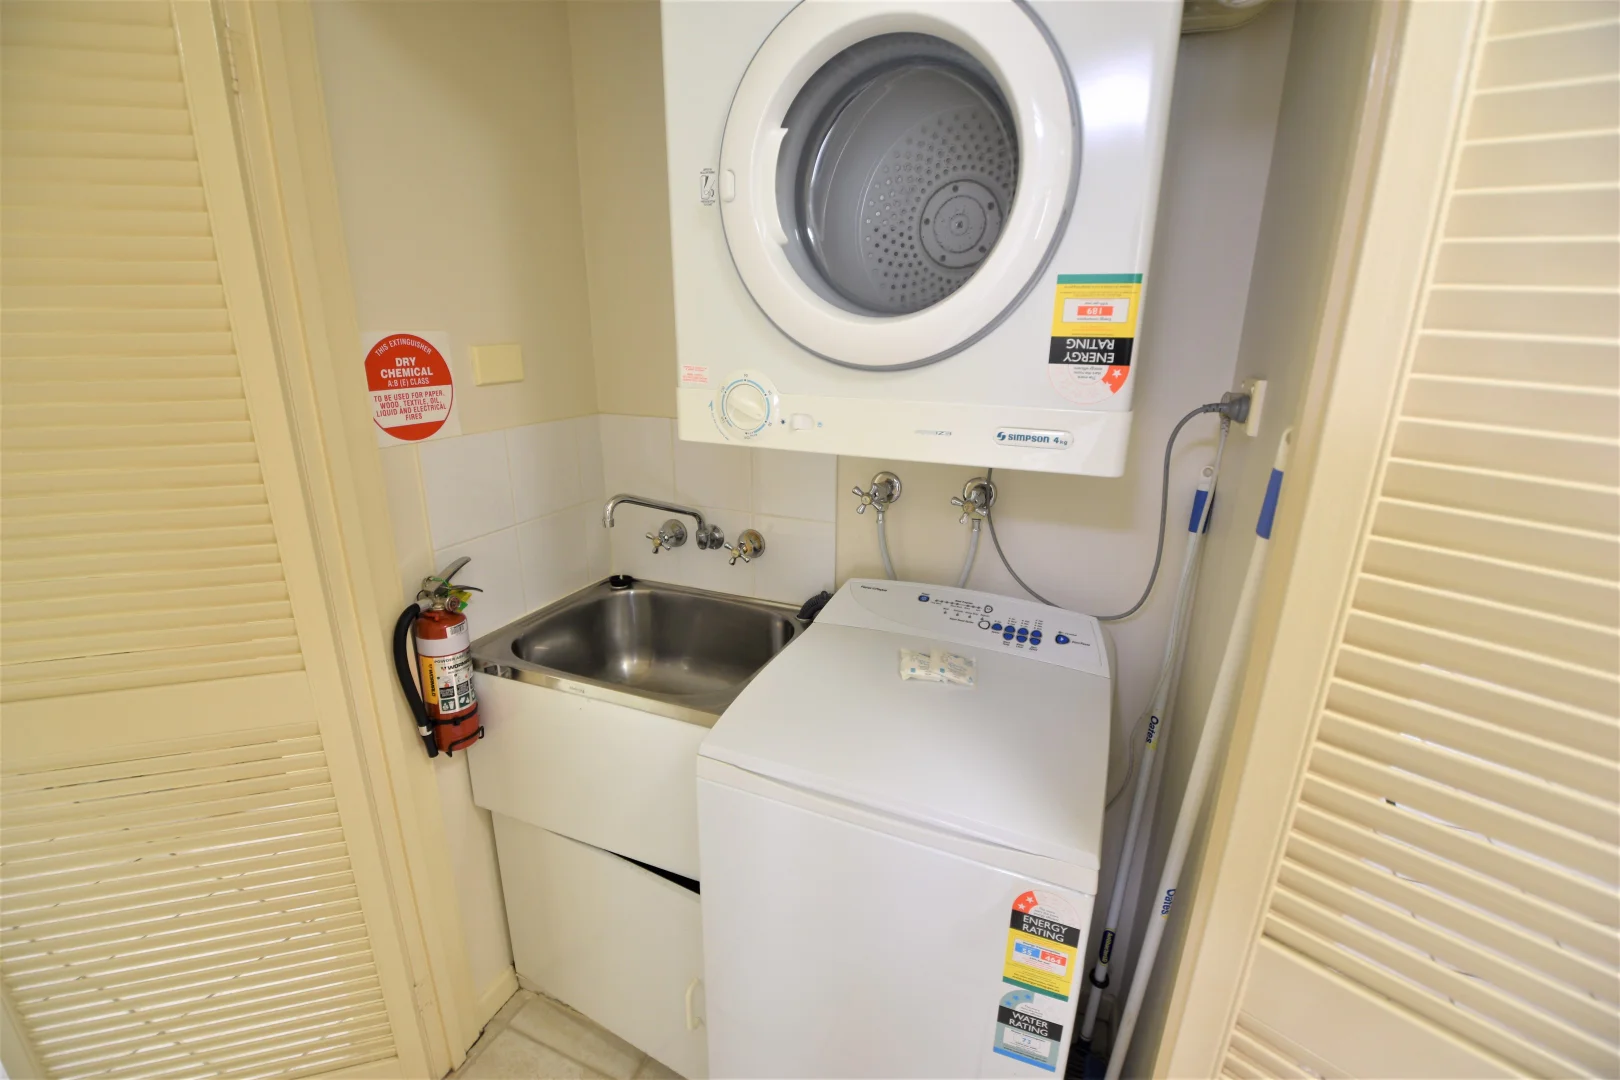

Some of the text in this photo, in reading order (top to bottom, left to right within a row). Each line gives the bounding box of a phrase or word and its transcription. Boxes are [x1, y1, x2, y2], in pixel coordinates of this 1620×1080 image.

[375, 338, 432, 356] THIS EXTINGUISHER
[1066, 338, 1114, 350] RATING
[395, 357, 416, 366] DRY
[1063, 352, 1114, 363] ENERGY
[380, 367, 433, 379] CHEMICAL
[410, 378, 430, 386] CLASS
[394, 392, 410, 400] USED
[376, 409, 398, 417] LIQUID
[414, 404, 446, 413] ELECTRICAL
[1008, 434, 1050, 443] SIMPSON
[1146, 715, 1159, 743] Oates
[1023, 915, 1068, 934] ENERGY
[1022, 924, 1064, 942] RATING
[1012, 1012, 1048, 1029] WATER
[1009, 1019, 1048, 1036] RATING
